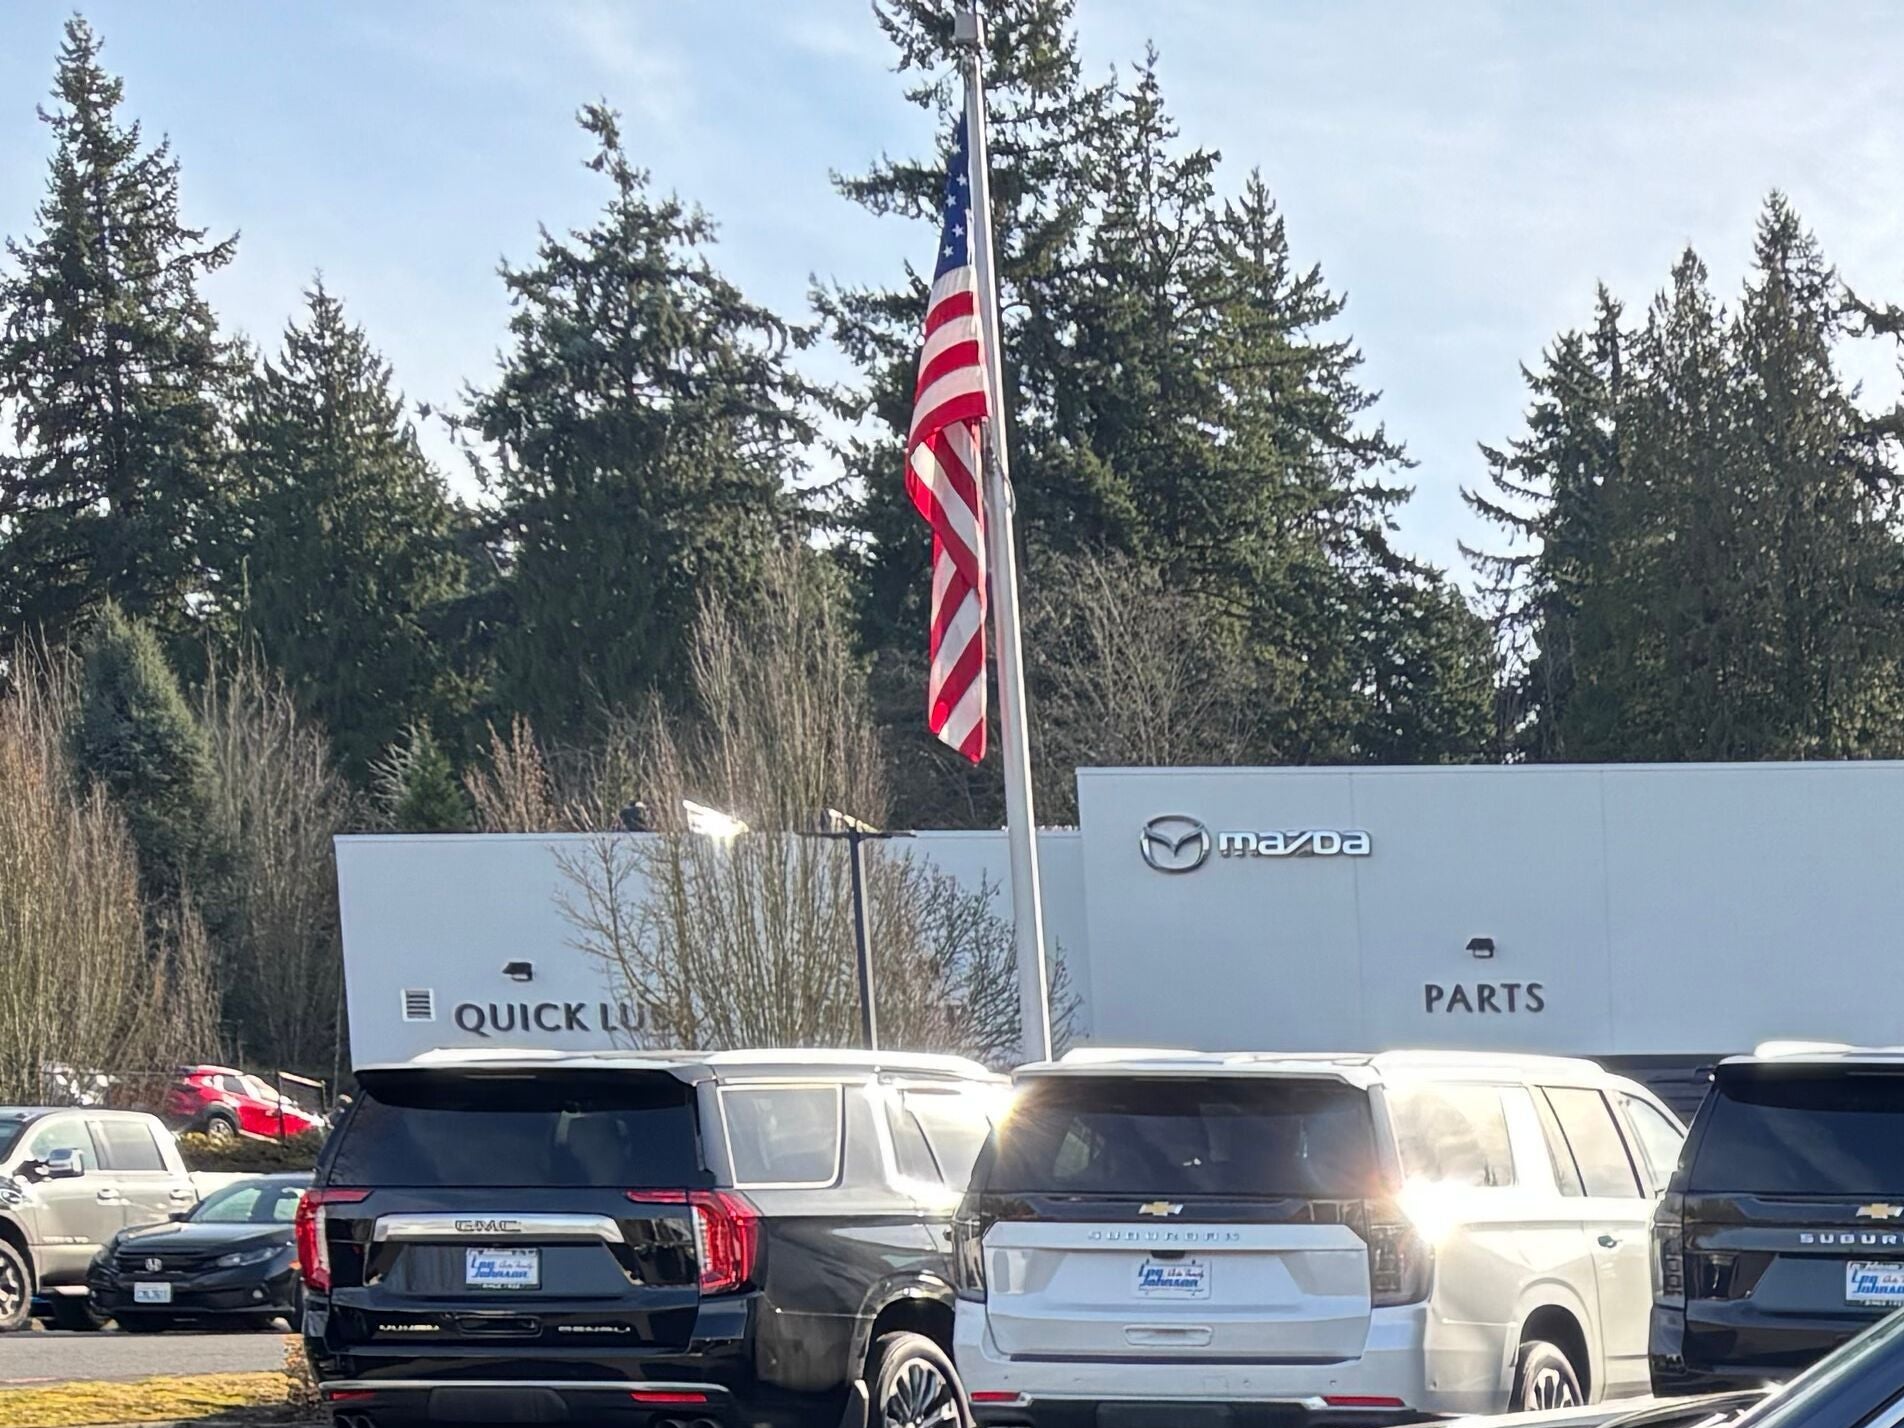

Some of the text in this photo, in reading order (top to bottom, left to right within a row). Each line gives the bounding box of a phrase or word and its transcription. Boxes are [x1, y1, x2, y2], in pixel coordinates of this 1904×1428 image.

[1218, 830, 1372, 858] mazda
[1424, 983, 1545, 1013] PARTS
[455, 1002, 674, 1037] QUICK LUB
[455, 1220, 521, 1232] GMC
